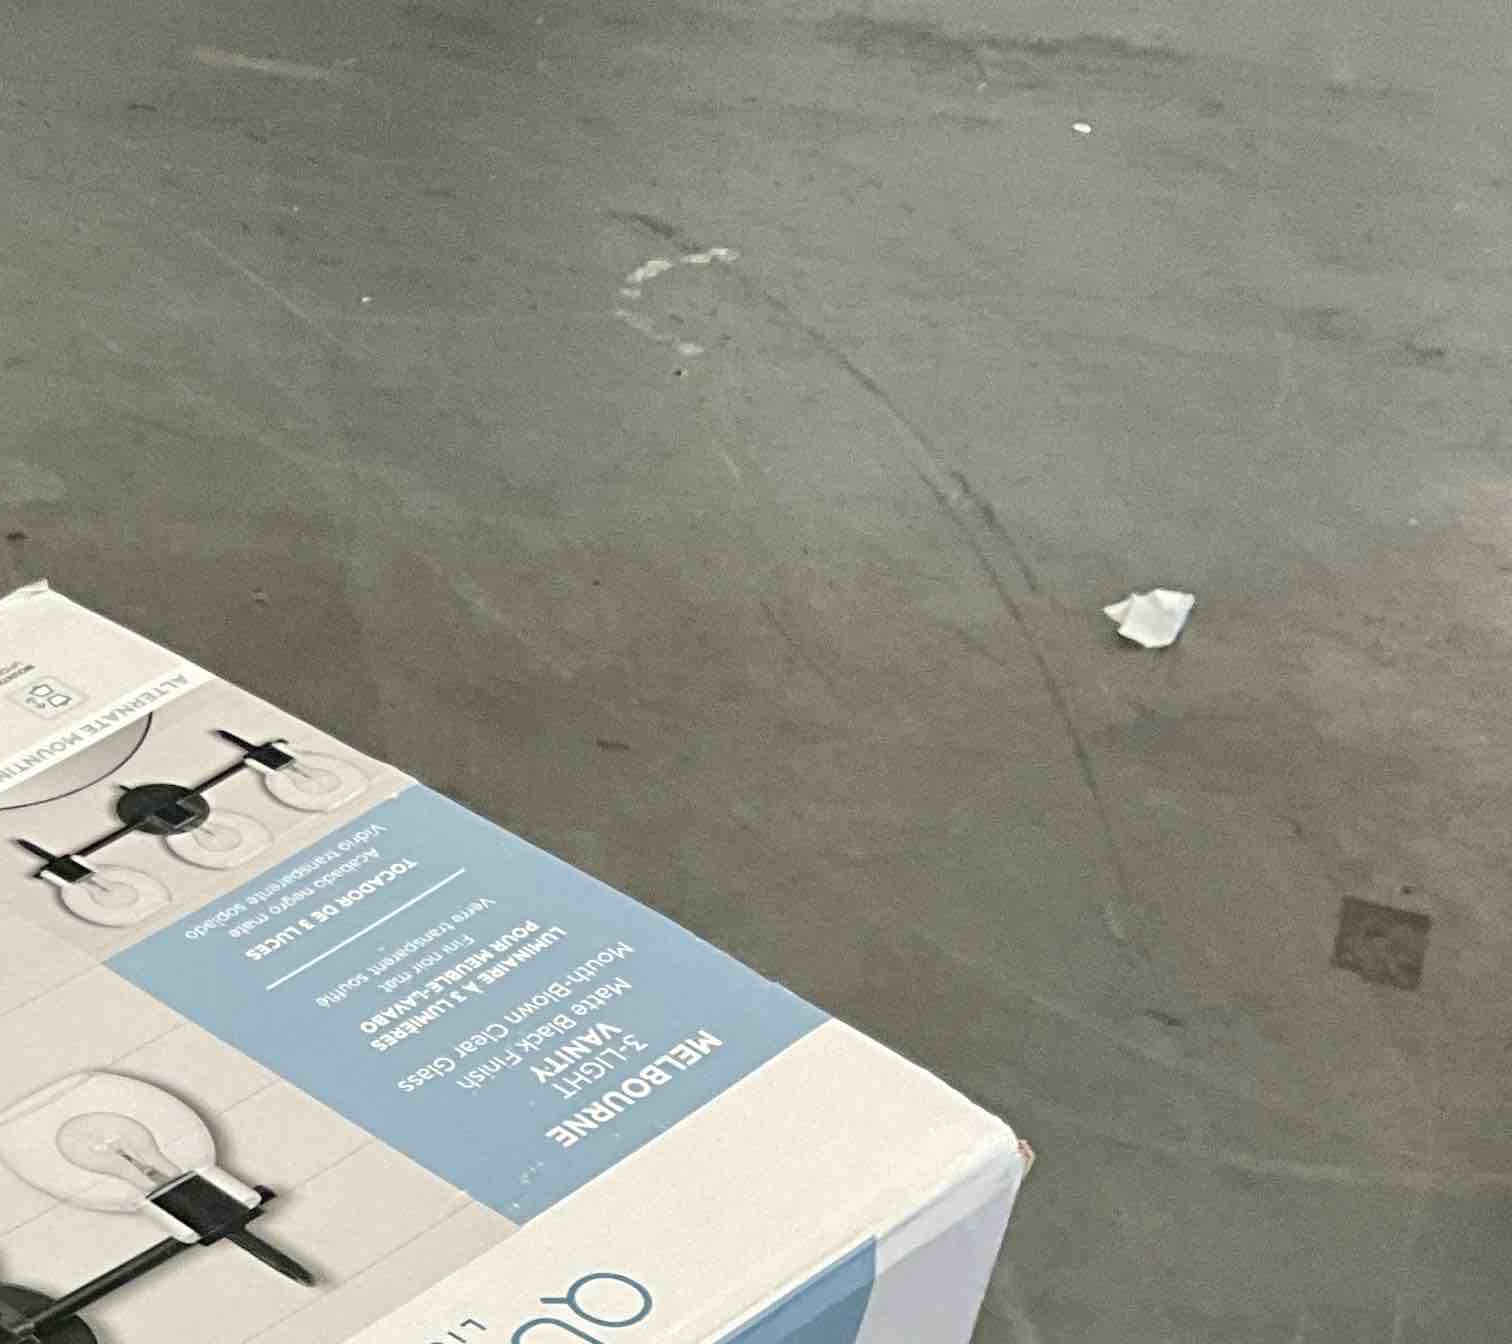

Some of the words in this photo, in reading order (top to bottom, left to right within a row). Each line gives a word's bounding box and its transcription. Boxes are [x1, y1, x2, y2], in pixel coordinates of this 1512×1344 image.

[76, 673, 192, 735] ALTERNATE
[335, 822, 387, 852] Vidrio
[239, 847, 341, 906] transparente
[309, 846, 382, 889] Acabado
[333, 856, 418, 907] TOCADOR
[262, 883, 315, 915] negro
[308, 903, 339, 921] DE
[447, 894, 496, 924] Verre
[178, 900, 248, 941] soplado
[224, 911, 271, 939] mate
[295, 918, 314, 929] 3
[487, 920, 540, 952] POUR
[242, 925, 301, 961] LUCES
[361, 918, 455, 976] transparent
[408, 951, 447, 974] noir
[440, 933, 476, 955] Fini
[473, 925, 568, 985] LUMINAIRE
[311, 972, 371, 1009] soufflé
[355, 948, 494, 1034] MEUBLE-LAVABO
[376, 970, 415, 993] mat
[446, 989, 467, 1002] 3
[458, 979, 486, 996] À
[500, 939, 636, 1026] Mouth-Blown
[566, 975, 633, 1018] Matte
[366, 997, 456, 1053] LUMIÈRES
[450, 1020, 510, 1058] Clear
[512, 1012, 577, 1053] Black
[453, 1048, 522, 1092] Finish
[521, 1018, 623, 1083] VANITY
[545, 1033, 649, 1099] 3-LIGHT
[392, 1054, 457, 1095] Glass
[542, 1028, 725, 1148] MELBOURNE
